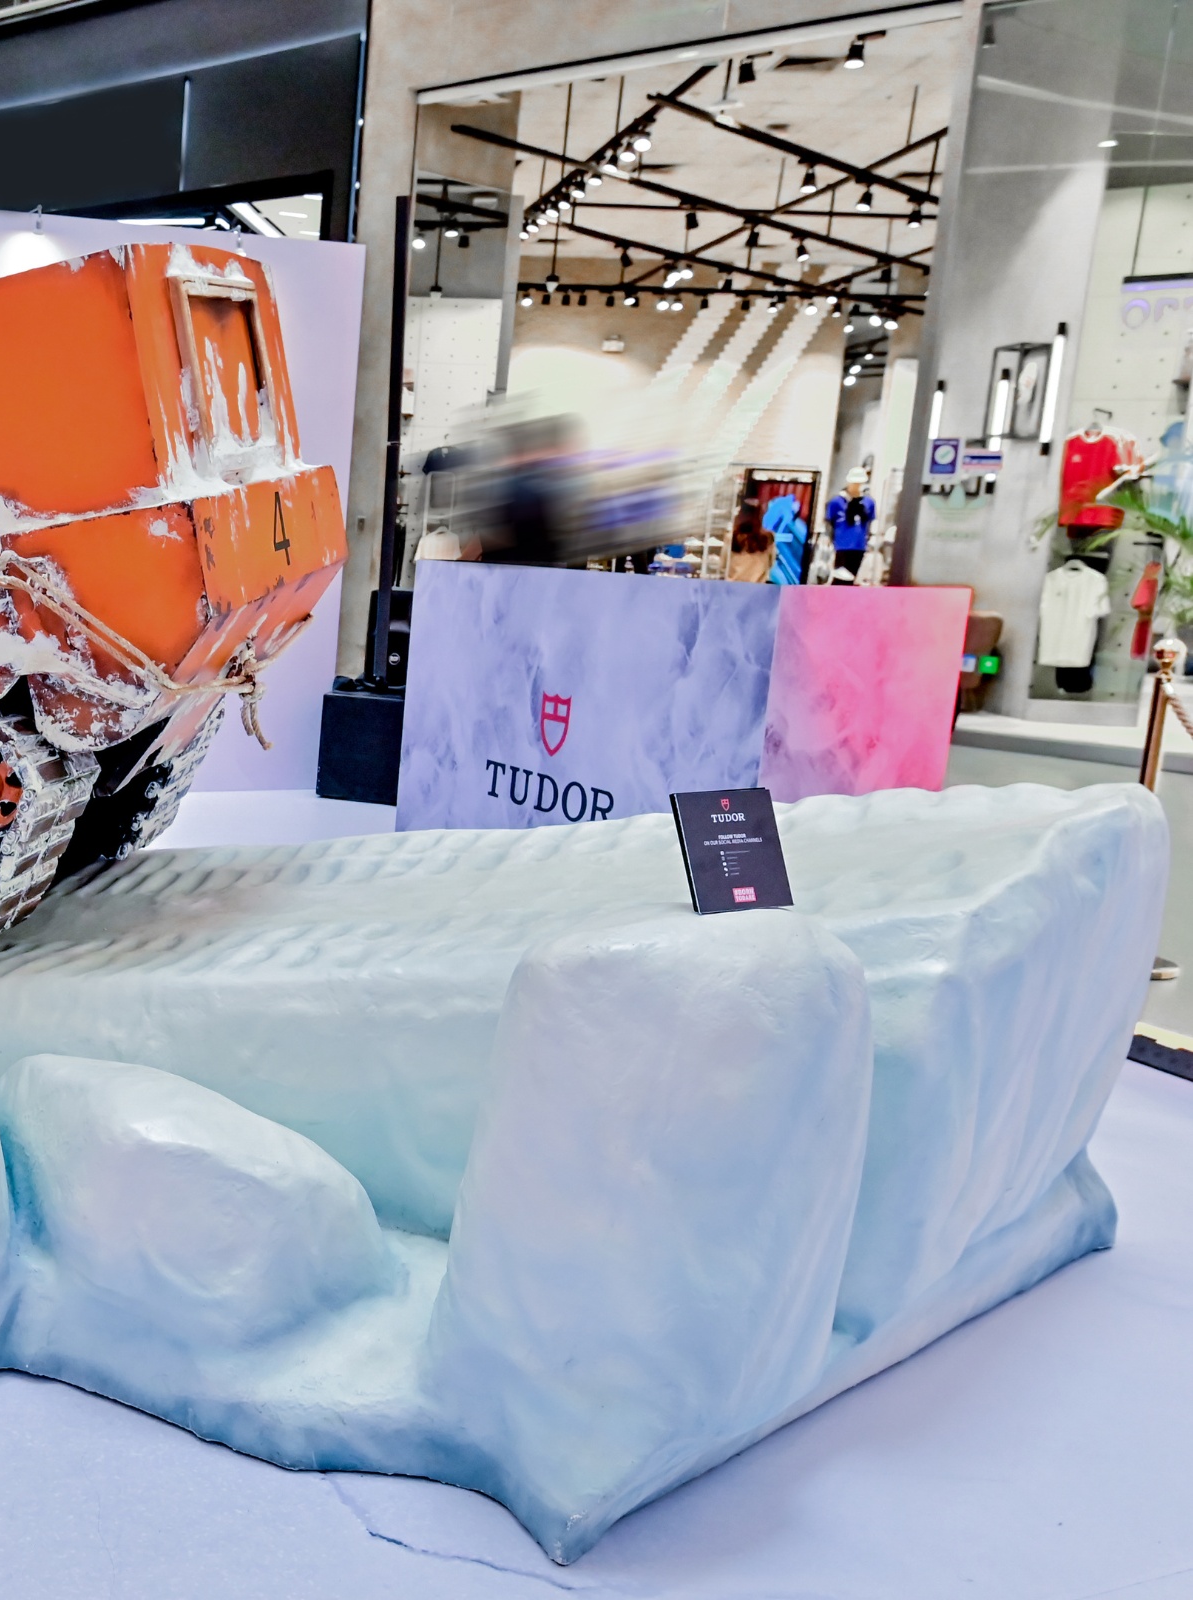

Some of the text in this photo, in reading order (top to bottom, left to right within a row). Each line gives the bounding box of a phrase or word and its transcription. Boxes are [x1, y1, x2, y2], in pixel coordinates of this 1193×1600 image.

[273, 491, 291, 566] 4
[485, 759, 615, 822] TUDOR
[710, 812, 746, 823] TUDOR
